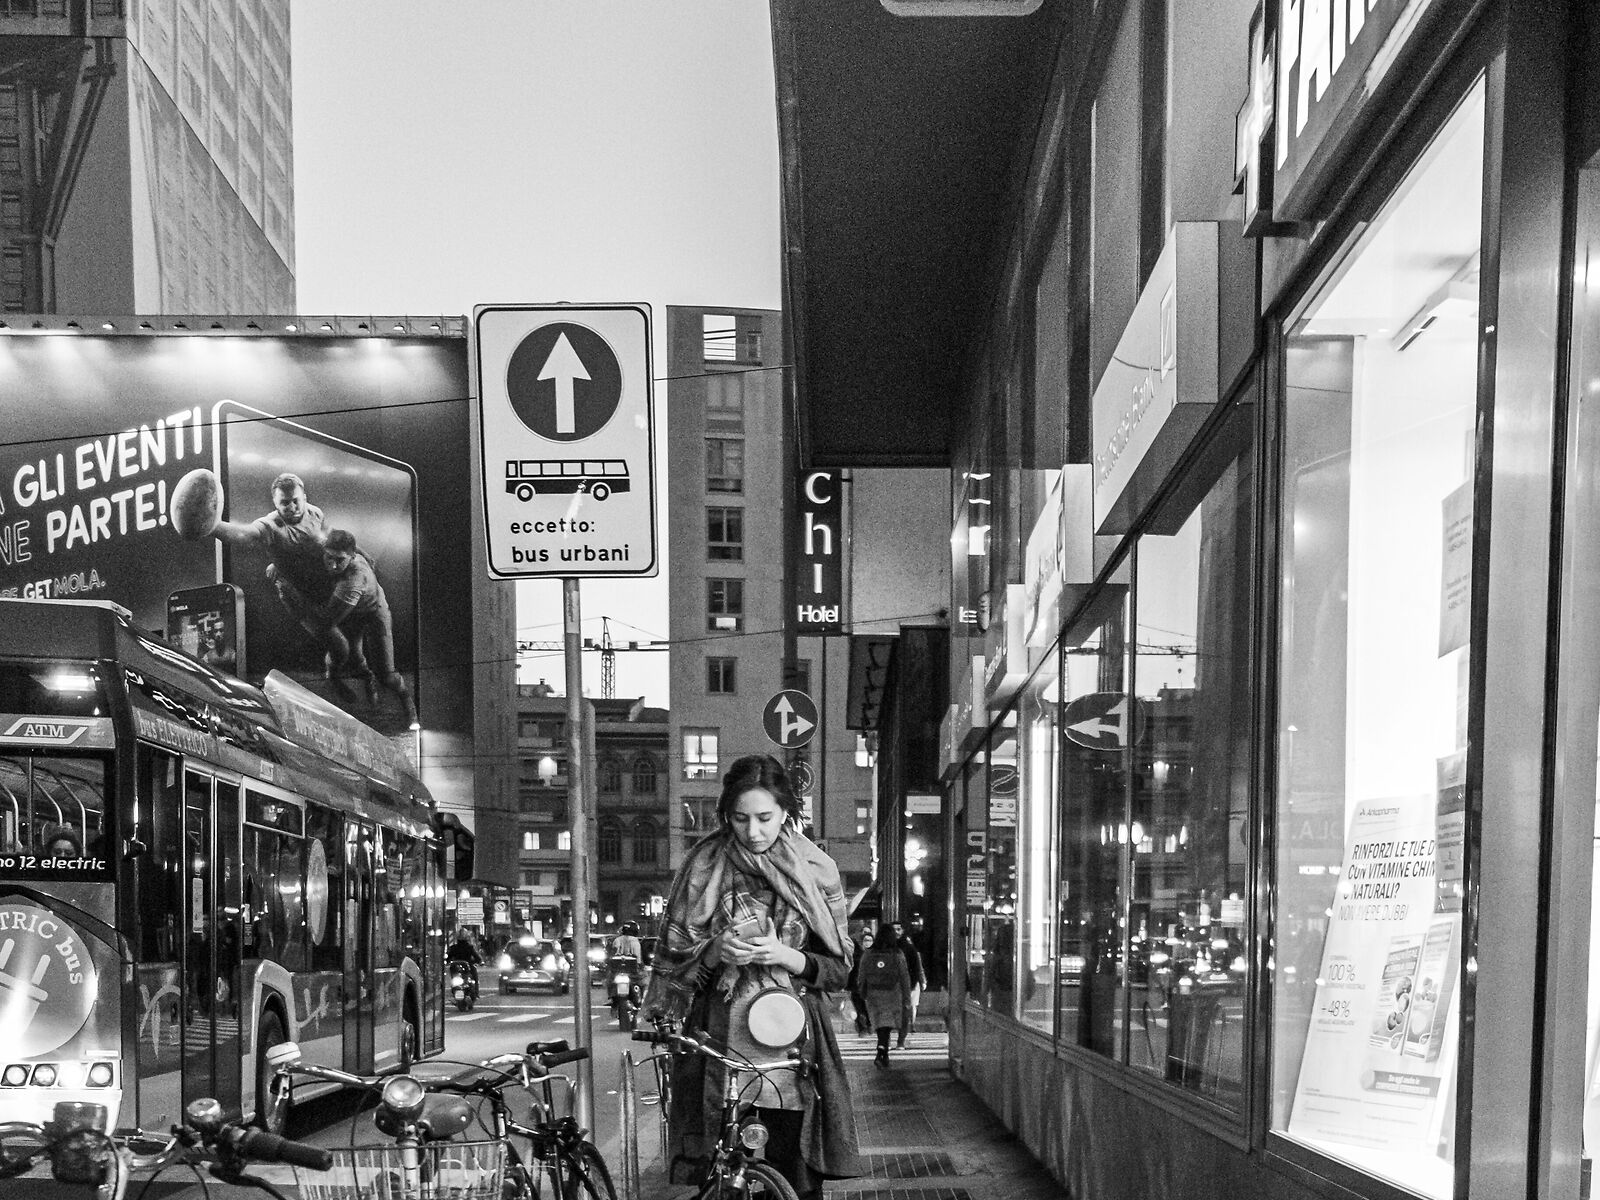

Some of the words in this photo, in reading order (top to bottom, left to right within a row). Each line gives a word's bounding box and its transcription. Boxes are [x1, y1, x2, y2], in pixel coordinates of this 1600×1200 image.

[13, 453, 65, 507] GLI
[75, 406, 202, 490] EVENTI
[46, 480, 168, 553] PARTE!
[510, 517, 595, 534] eccetto:
[511, 546, 550, 563] bus
[560, 544, 629, 562] urbani
[798, 604, 839, 622] Hotel
[24, 724, 65, 738] ATM
[1352, 842, 1396, 860] RINFORZI
[1395, 841, 1409, 858] LE
[1408, 840, 1427, 857] TUE
[19, 856, 36, 868] 12
[41, 856, 106, 870] electric
[1367, 862, 1412, 879] VITAMINE
[55, 936, 84, 985] bus
